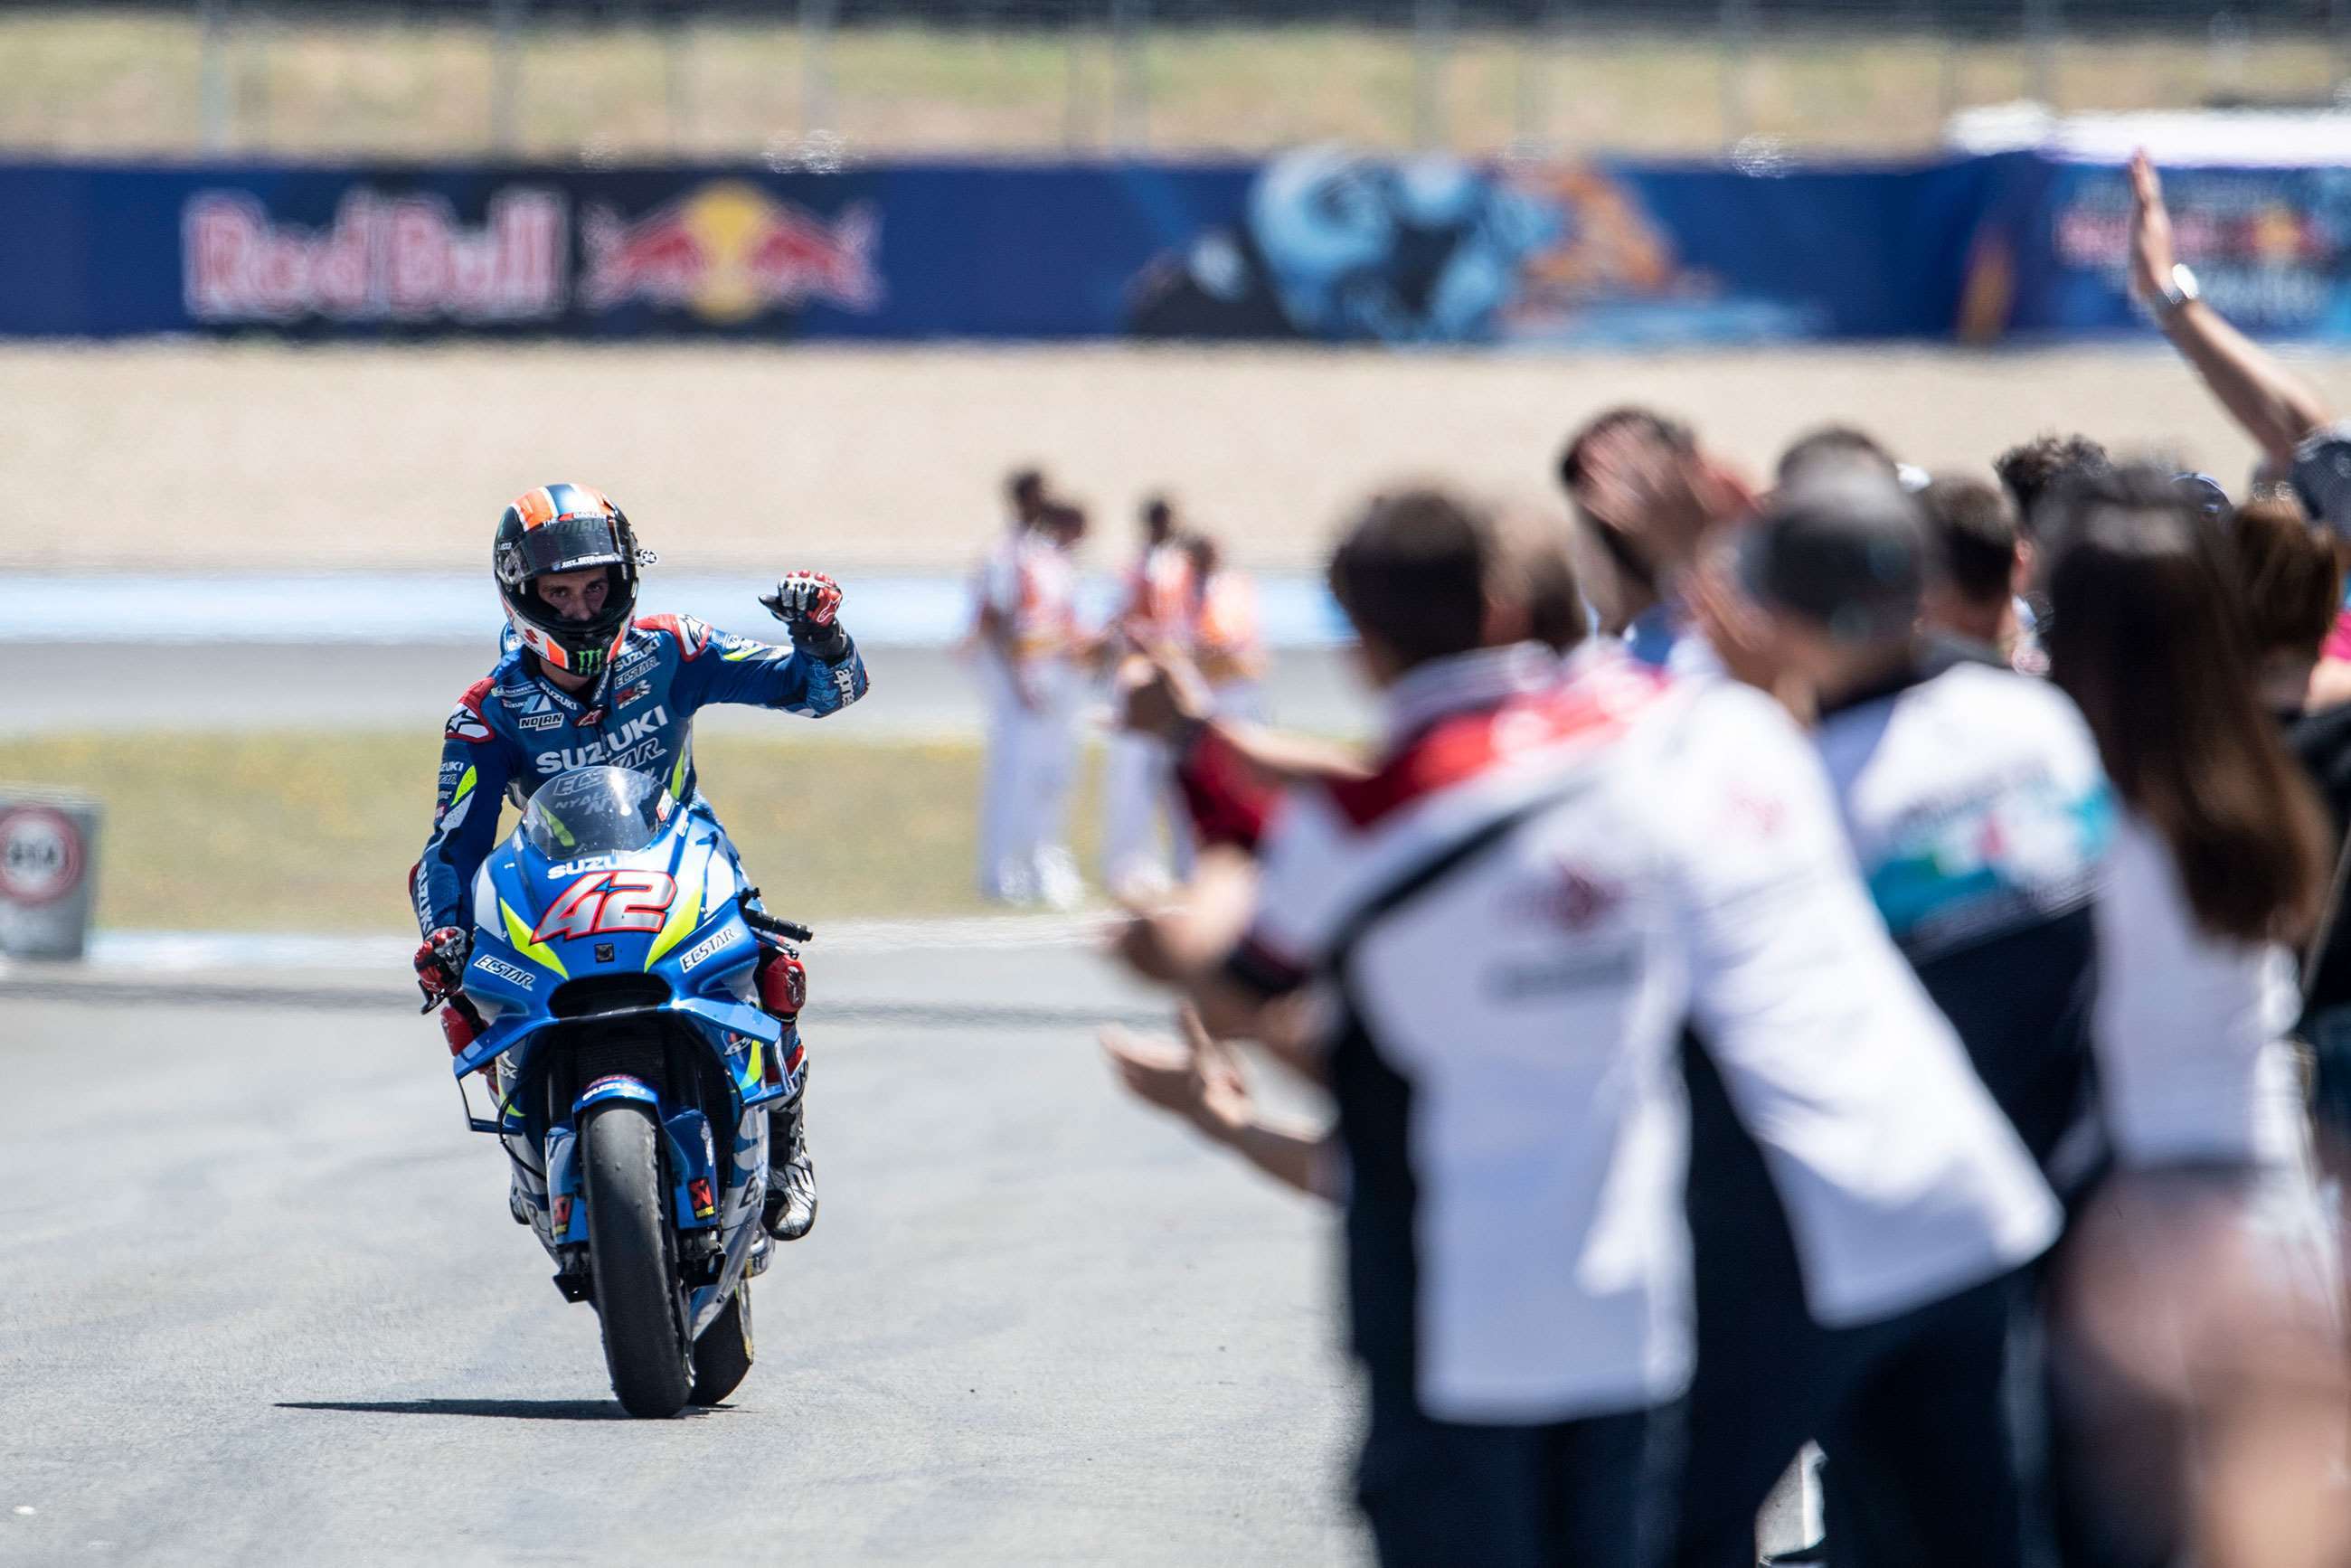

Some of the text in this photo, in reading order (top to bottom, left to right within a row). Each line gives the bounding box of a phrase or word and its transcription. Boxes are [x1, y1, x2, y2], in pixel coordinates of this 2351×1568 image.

[615, 638, 661, 672] SUZUKI
[615, 656, 661, 690] ECSTAR
[539, 681, 578, 711] SUZUKI
[519, 713, 563, 731] NOLAN
[535, 705, 669, 774] SUZUKI
[417, 861, 435, 935] SUZUKI
[529, 869, 677, 946] 42
[678, 926, 737, 974] ECSTAR
[473, 954, 536, 991] ECSTAR
